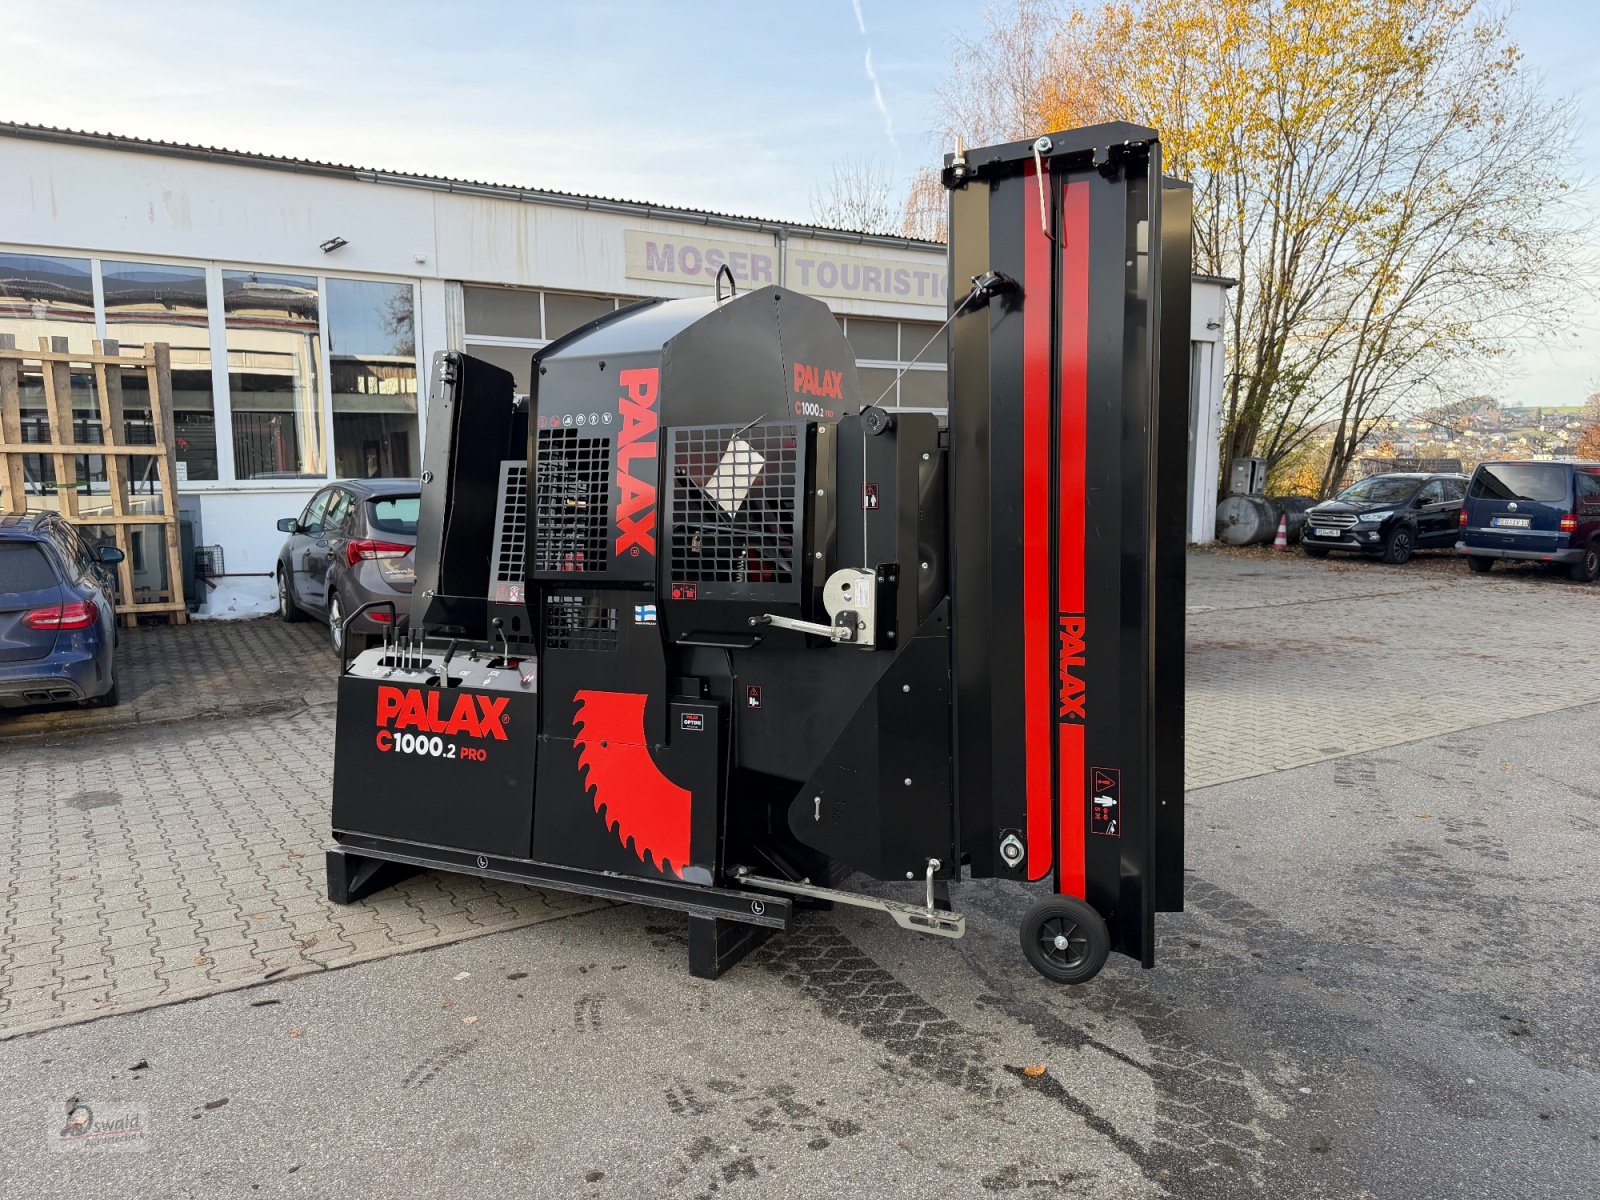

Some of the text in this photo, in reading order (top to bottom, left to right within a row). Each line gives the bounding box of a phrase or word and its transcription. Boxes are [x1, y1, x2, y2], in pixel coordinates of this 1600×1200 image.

[645, 241, 772, 282] MOSER
[793, 363, 843, 399] PALAX
[795, 401, 823, 417] C1000.2
[615, 367, 659, 557] PALAX
[1060, 616, 1086, 719] PALAX
[376, 685, 511, 741] PALAX
[376, 730, 487, 762] C1000.2 PRO
